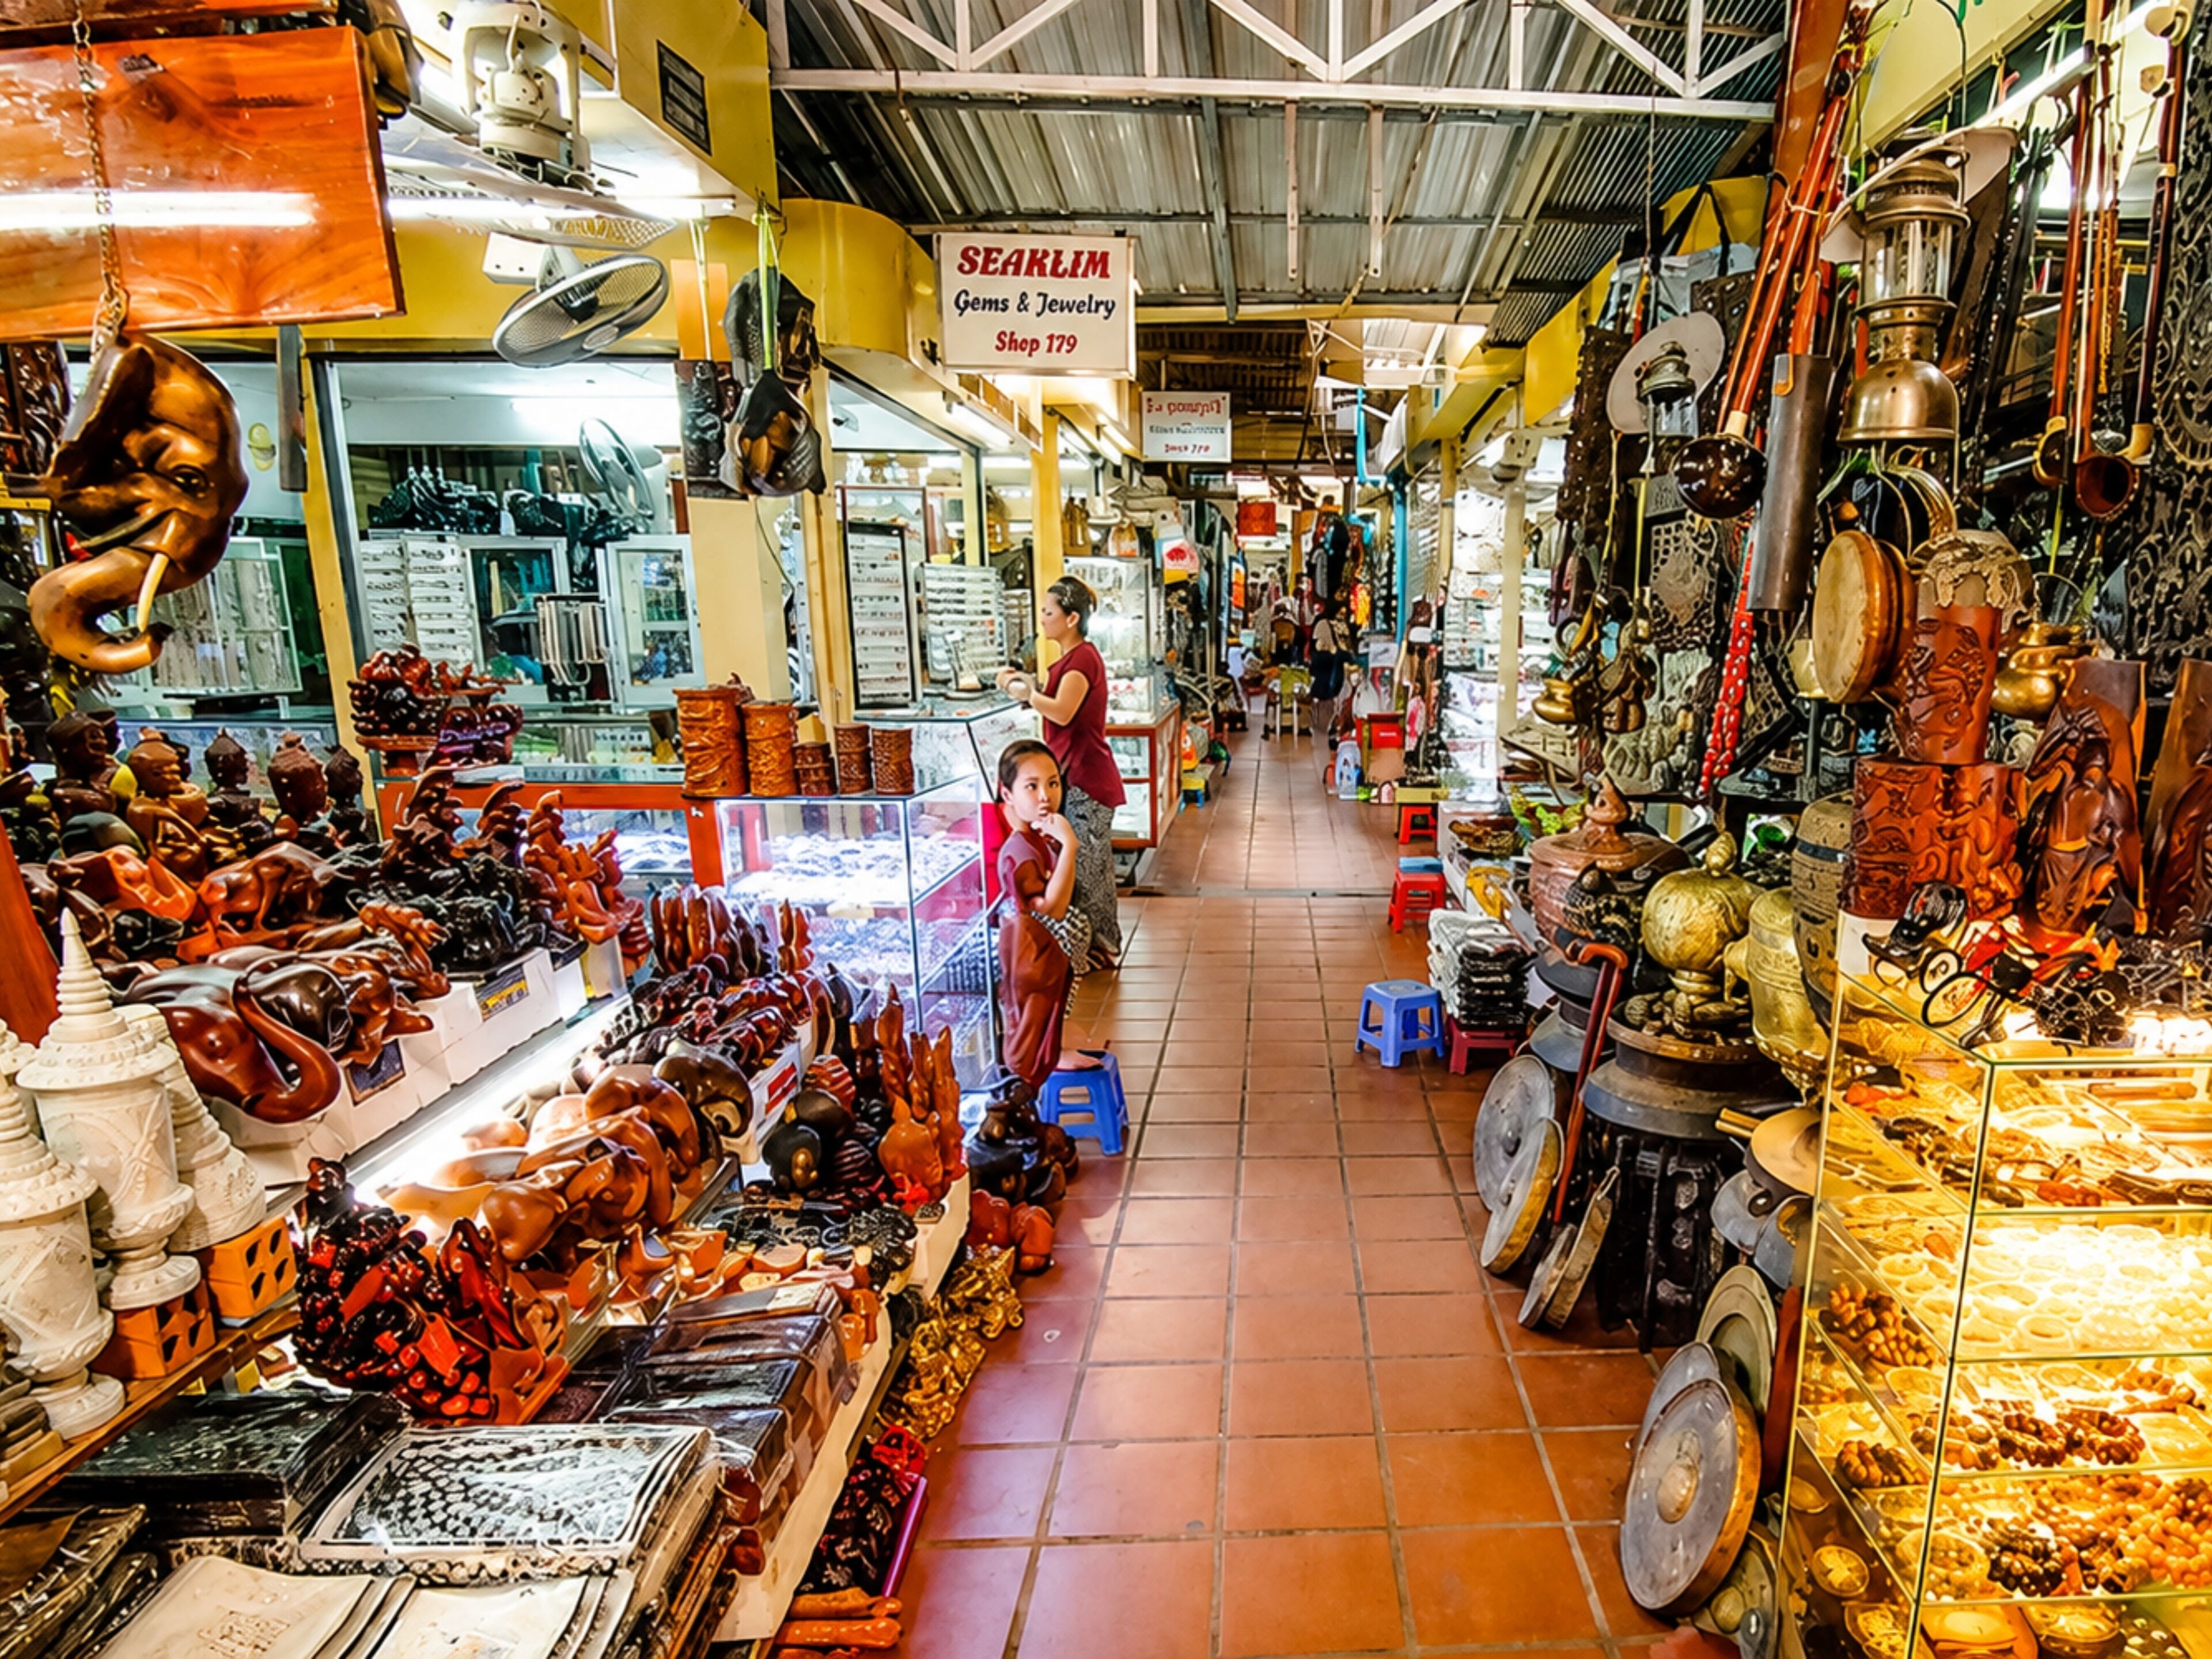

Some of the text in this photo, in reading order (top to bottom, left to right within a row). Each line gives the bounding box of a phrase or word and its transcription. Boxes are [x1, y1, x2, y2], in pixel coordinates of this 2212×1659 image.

[957, 245, 1111, 279] SEAKLIM
[953, 289, 1116, 320] Gems & Jewelry
[994, 330, 1078, 358] Shop 179
